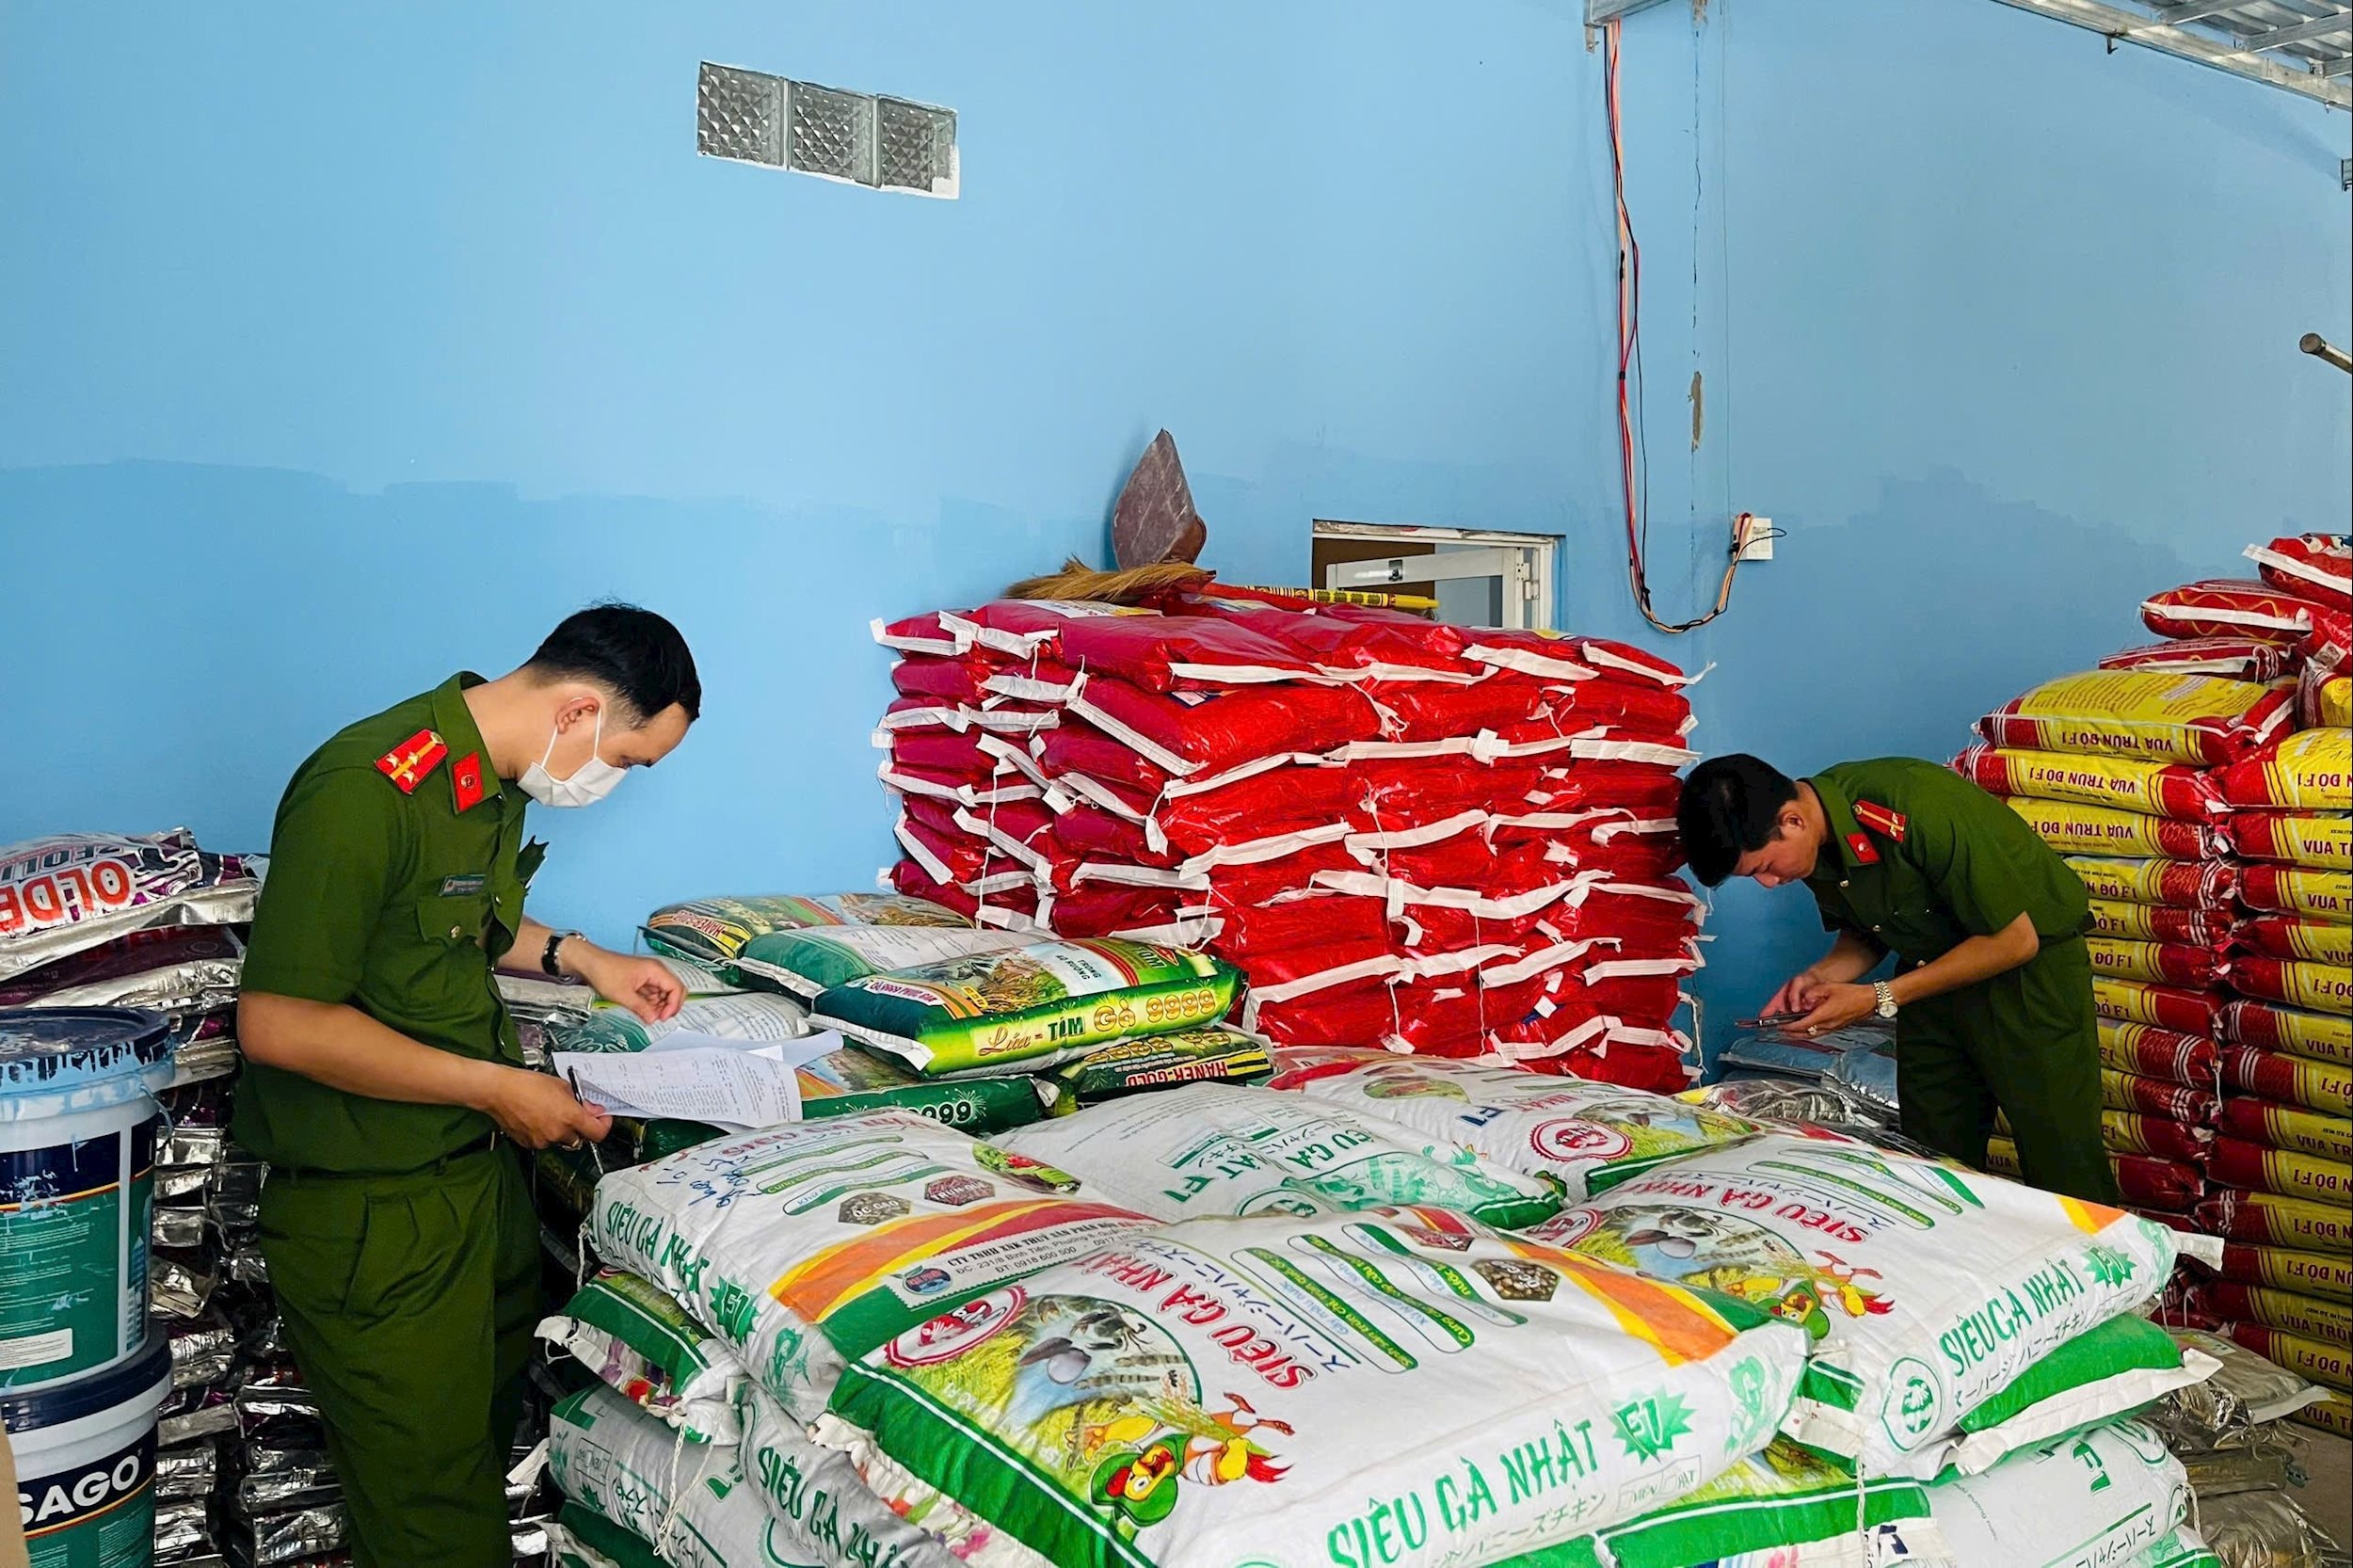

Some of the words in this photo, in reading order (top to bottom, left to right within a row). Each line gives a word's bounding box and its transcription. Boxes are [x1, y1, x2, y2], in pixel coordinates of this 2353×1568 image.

[2062, 731, 2077, 746] F1
[2145, 738, 2173, 752] VUA
[2029, 767, 2044, 779] F1
[2297, 774, 2314, 788] F1
[2110, 780, 2135, 793] VUA
[2318, 773, 2341, 792] ĐỎ
[2041, 821, 2059, 838] ĐỎ
[2065, 823, 2102, 839] TRÙN
[2107, 824, 2134, 839] VUA
[2303, 840, 2334, 856] VUA
[2100, 880, 2118, 895] ĐỎ
[2121, 887, 2137, 899] F1
[2307, 894, 2339, 909] VUA
[2110, 918, 2126, 932] F1
[2095, 948, 2114, 965] ĐỎ
[2117, 954, 2132, 968] F1
[2313, 979, 2332, 995] F1
[2114, 1005, 2130, 1018] F1
[979, 1023, 1032, 1056] Lúa
[1093, 998, 1136, 1032] Gà
[1145, 989, 1216, 1022] 9999
[2306, 1039, 2336, 1055] VUA
[1125, 1062, 1227, 1087] HANER-GOLD
[2321, 1078, 2341, 1094] F1
[907, 1099, 974, 1126] 999
[2297, 1134, 2327, 1151] VUA
[1988, 1154, 2012, 1167] VUA
[2293, 1168, 2312, 1186] F1
[1719, 1187, 1783, 1212] GÀ
[605, 1199, 635, 1243] SIÊU
[636, 1211, 659, 1259] GÀ
[1795, 1204, 1870, 1245] SIÊU
[2293, 1218, 2313, 1236] F1
[947, 1255, 969, 1269] CTY
[1056, 1247, 1077, 1260] 500
[976, 1256, 1003, 1272] 231/8
[2286, 1259, 2304, 1277] F1
[1158, 1280, 1226, 1328] GÀ
[1940, 1309, 1999, 1379] SIÊU
[1994, 1282, 2030, 1346] GÀ
[2030, 1256, 2085, 1323] NHẬT
[2281, 1314, 2312, 1332] VUA
[1438, 1315, 1474, 1346] Cung
[1214, 1321, 1318, 1391] SIÊU
[19, 1455, 140, 1526] SAGO
[758, 1446, 809, 1521] SIÊU
[1327, 1489, 1428, 1568] SIÊU
[1433, 1455, 1498, 1535] GÀ
[1501, 1418, 1600, 1504] NHẬT
